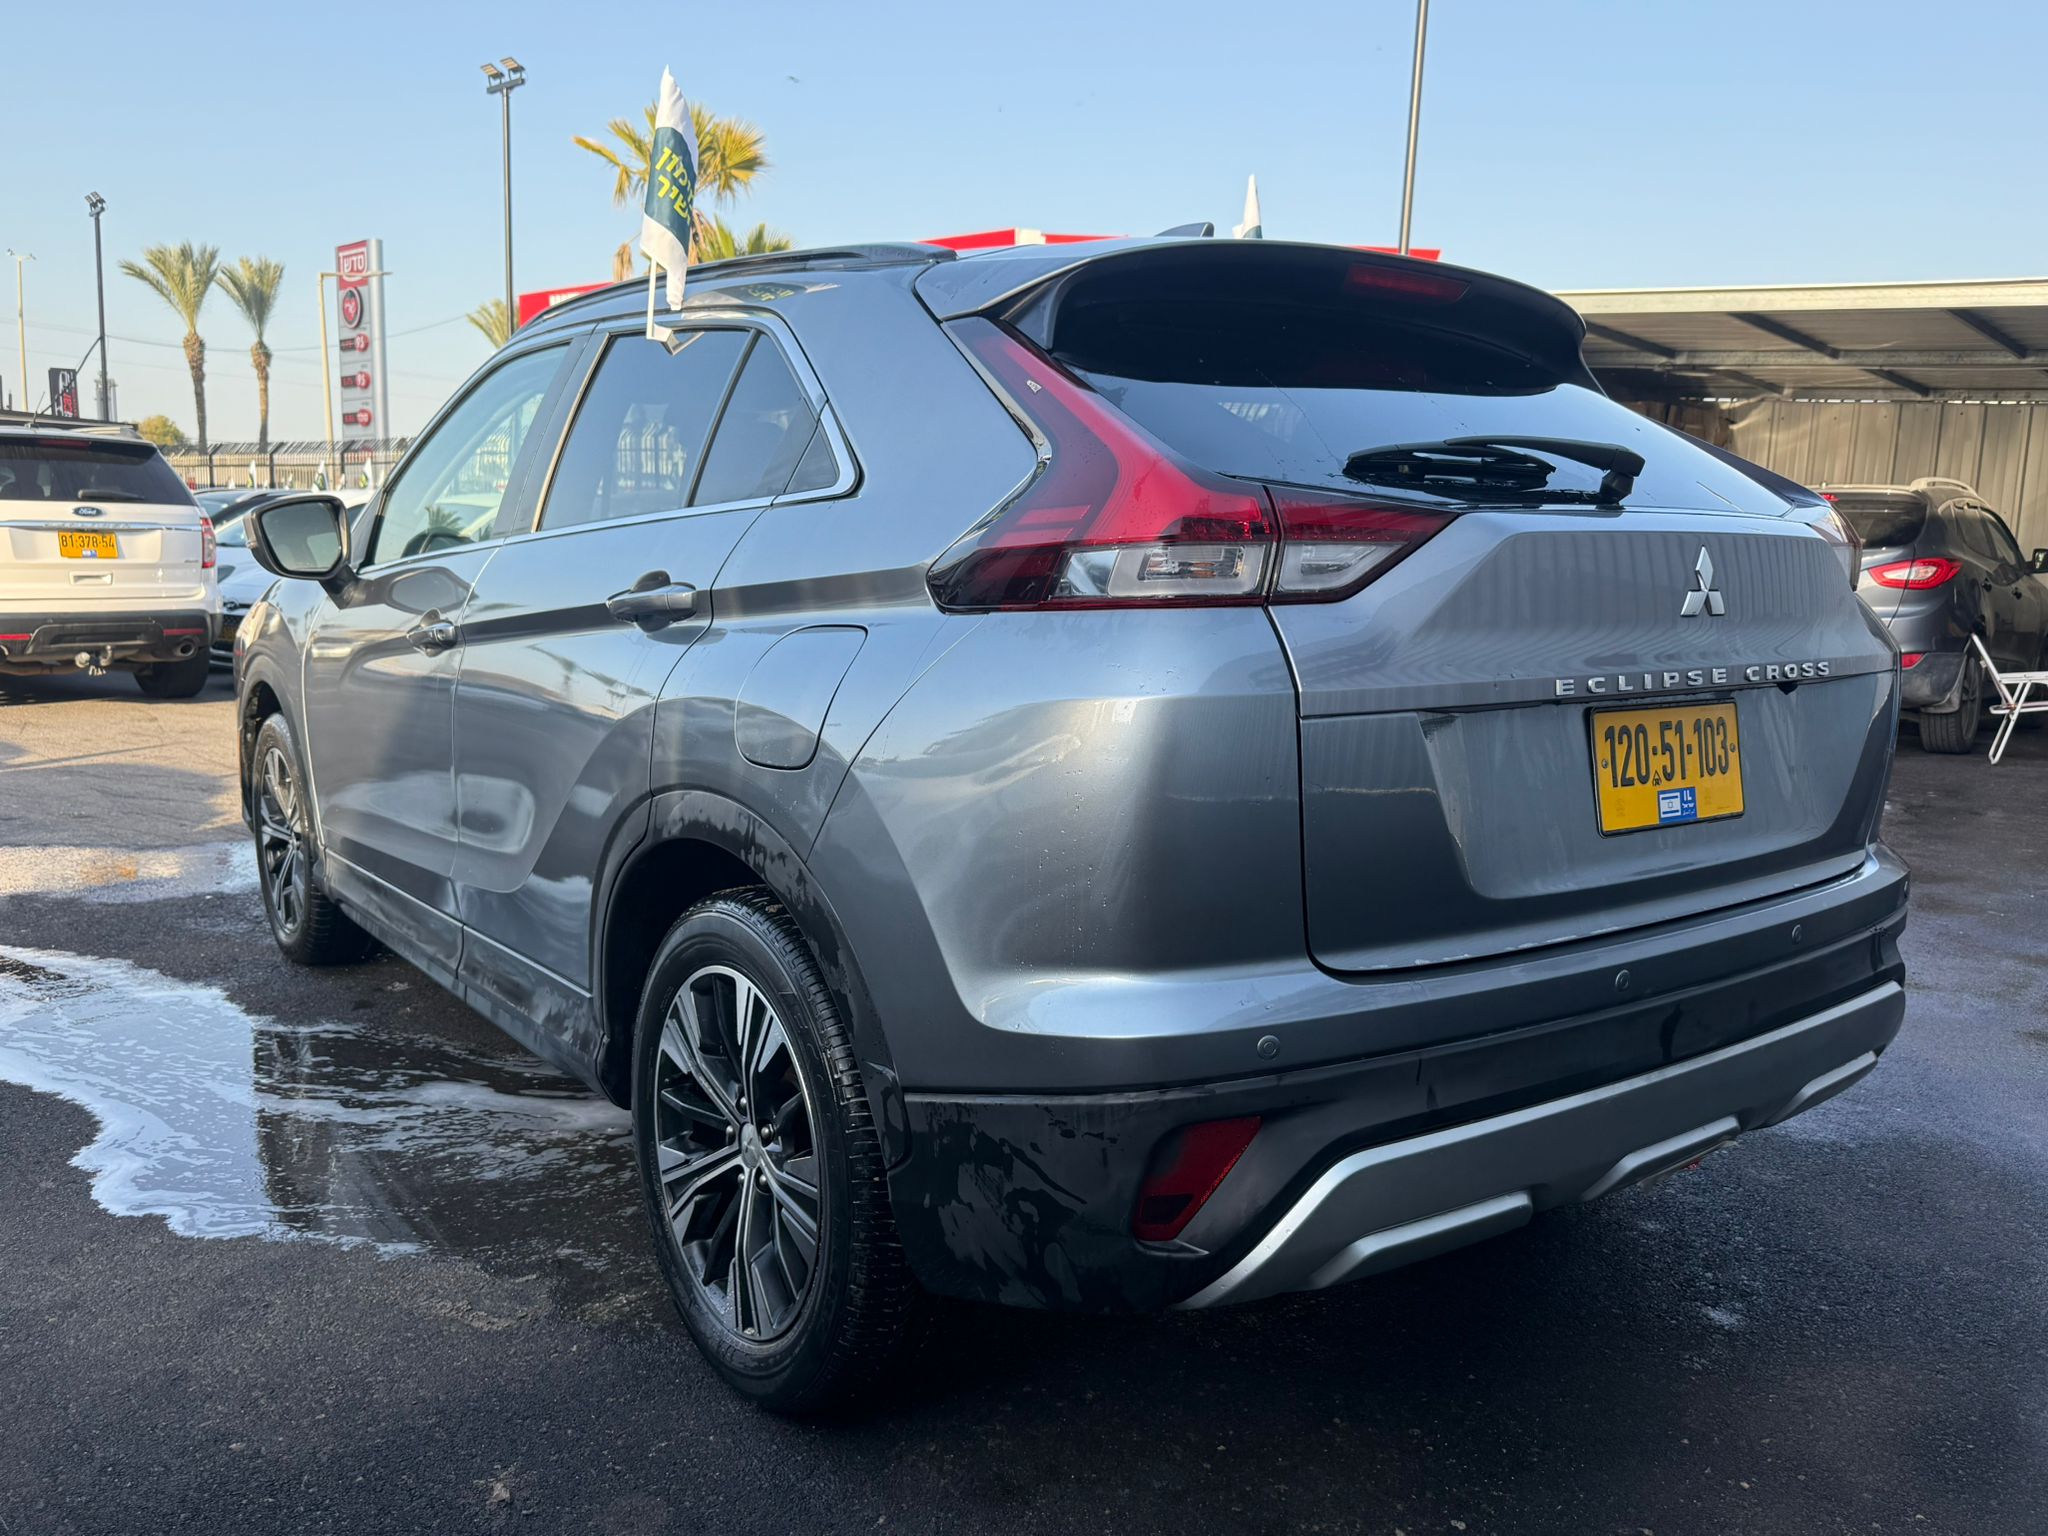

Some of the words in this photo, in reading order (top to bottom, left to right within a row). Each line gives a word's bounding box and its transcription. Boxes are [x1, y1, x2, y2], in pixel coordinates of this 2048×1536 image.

[1555, 667, 1727, 696] ECLIPSE
[1746, 661, 1830, 682] CROSS
[1604, 716, 1730, 788] 120-51-103
[1683, 789, 1692, 802] IL
